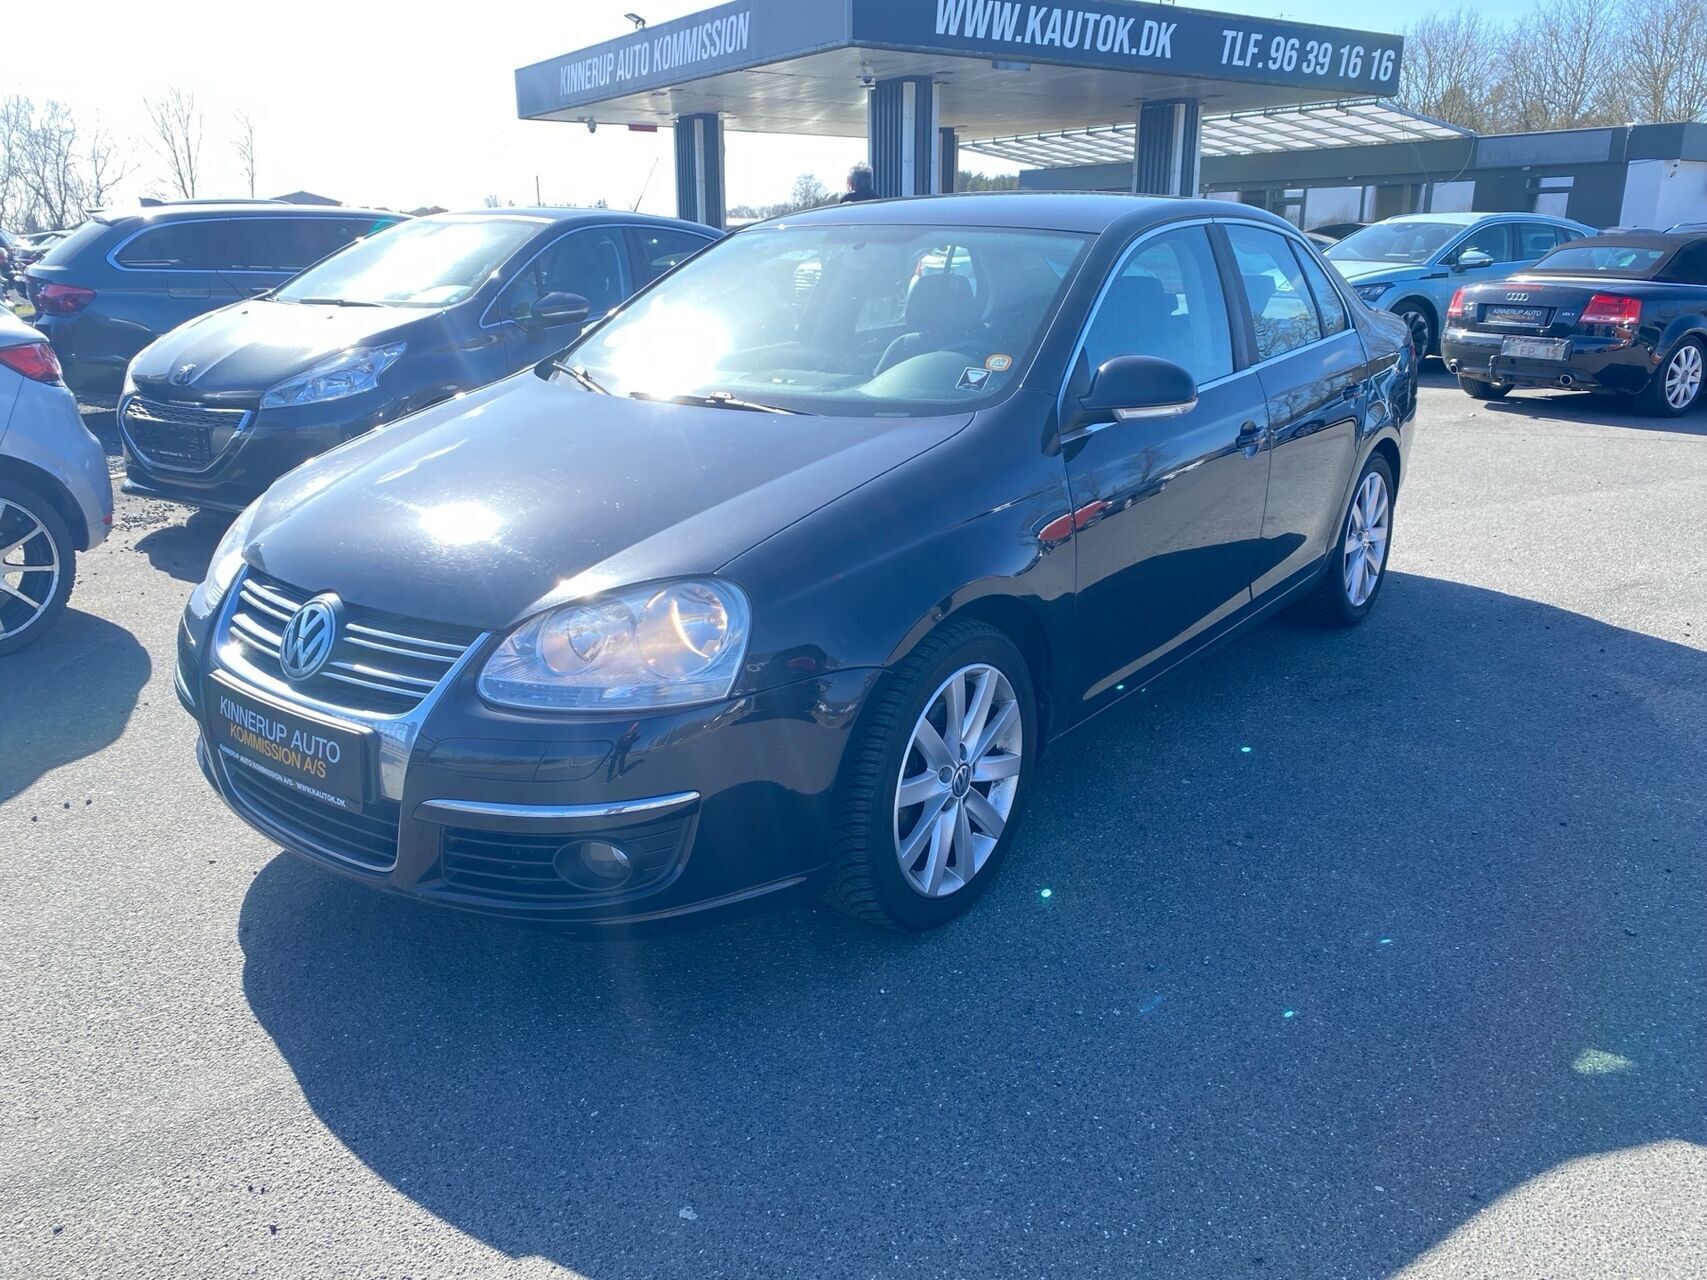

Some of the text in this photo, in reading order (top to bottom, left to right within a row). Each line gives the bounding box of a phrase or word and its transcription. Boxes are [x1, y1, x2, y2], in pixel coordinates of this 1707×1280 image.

[560, 11, 750, 96] KINNERUP AUTO KOMMISSION
[935, 0, 1178, 59] WWW.KAUTOK.DK
[1221, 29, 1396, 82] TLF. 96 39 16 16
[220, 696, 340, 764] KINNERUP AUTO
[230, 722, 327, 778] KOMMISSION A/S
